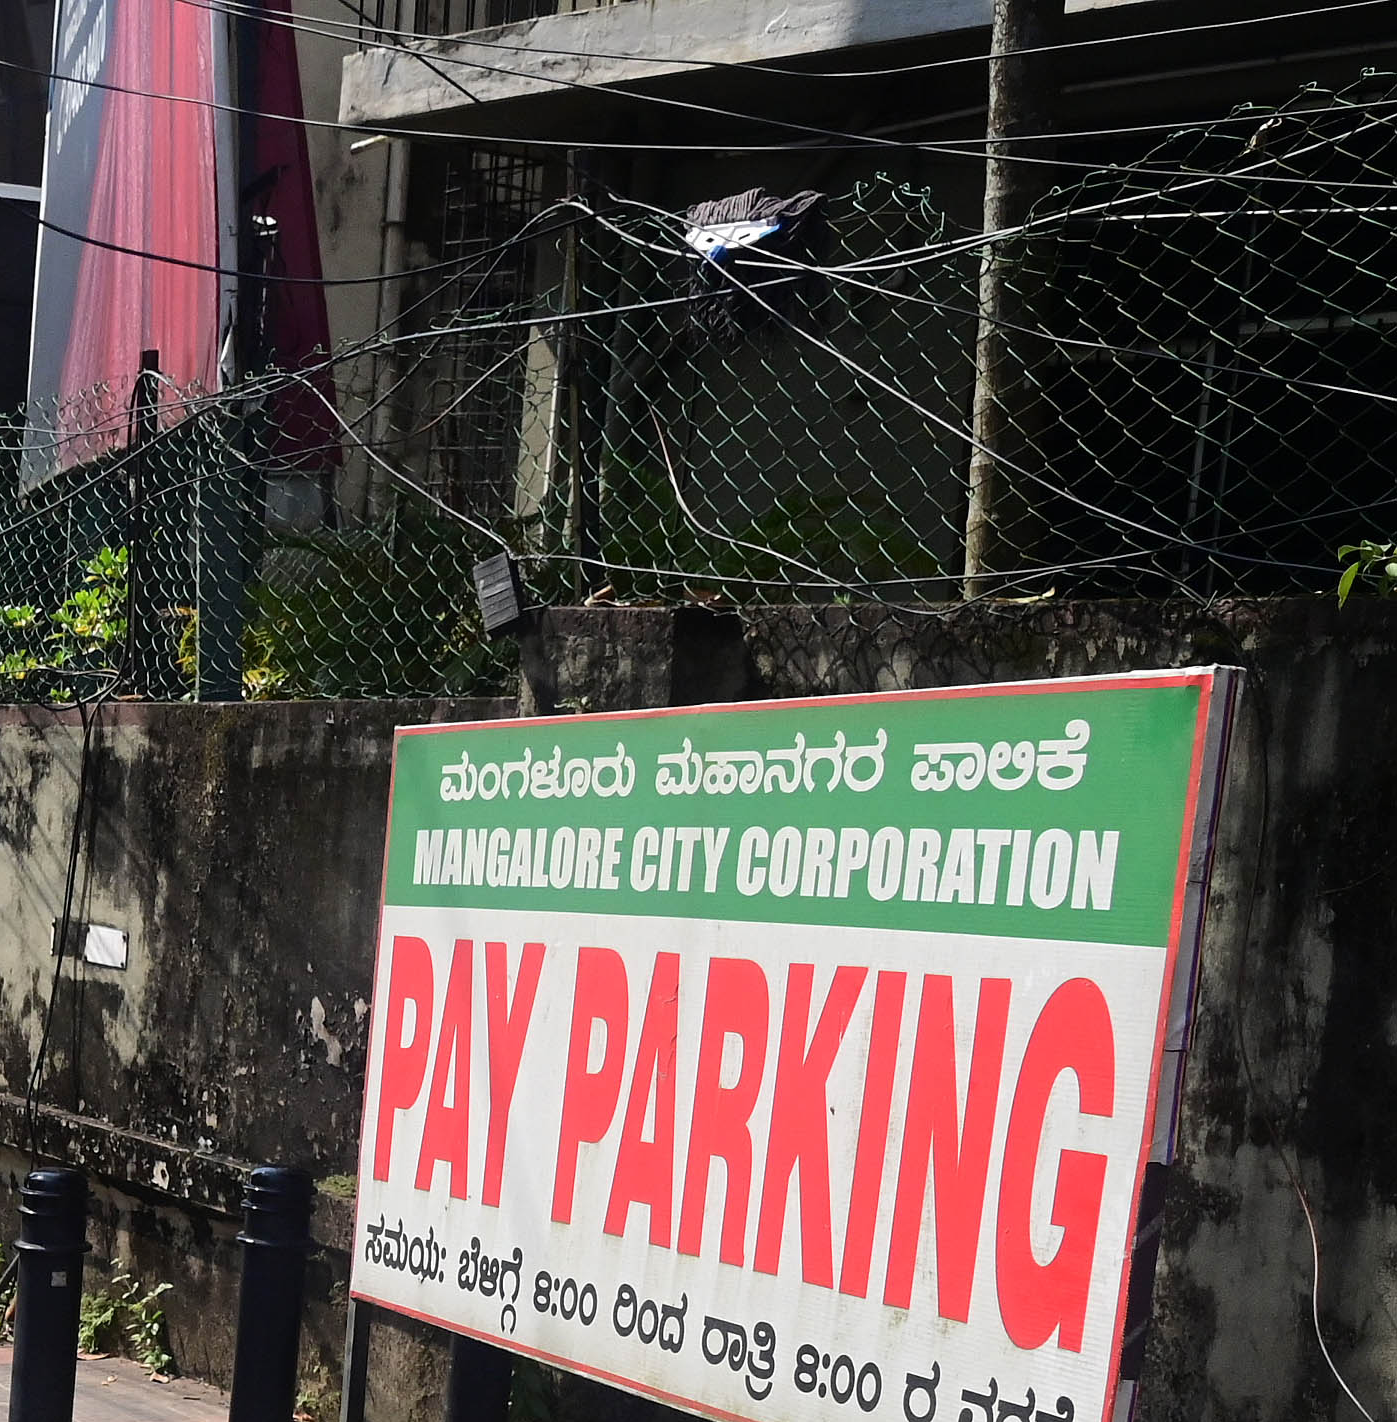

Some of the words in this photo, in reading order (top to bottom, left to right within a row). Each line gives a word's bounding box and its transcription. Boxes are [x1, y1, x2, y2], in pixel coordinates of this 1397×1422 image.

[439, 741, 636, 802] ಮಂಗಳೂರು
[655, 728, 887, 798] ಮಹಾನಗರ
[910, 719, 1090, 793] ಪಾಲಿಕೆ
[413, 827, 621, 890] MANGALORE
[631, 826, 731, 894] CITY
[735, 826, 1121, 912] CORPORATION
[372, 935, 546, 1208] PAY
[551, 946, 1115, 1352] PARKING
[365, 1213, 447, 1283] ಸಮಯ:
[457, 1236, 523, 1334] ಬೆಳಿಗ್ಗೆ
[613, 1284, 688, 1354] ರಿಂದ
[701, 1315, 776, 1401] ರಾತ್ರಿ
